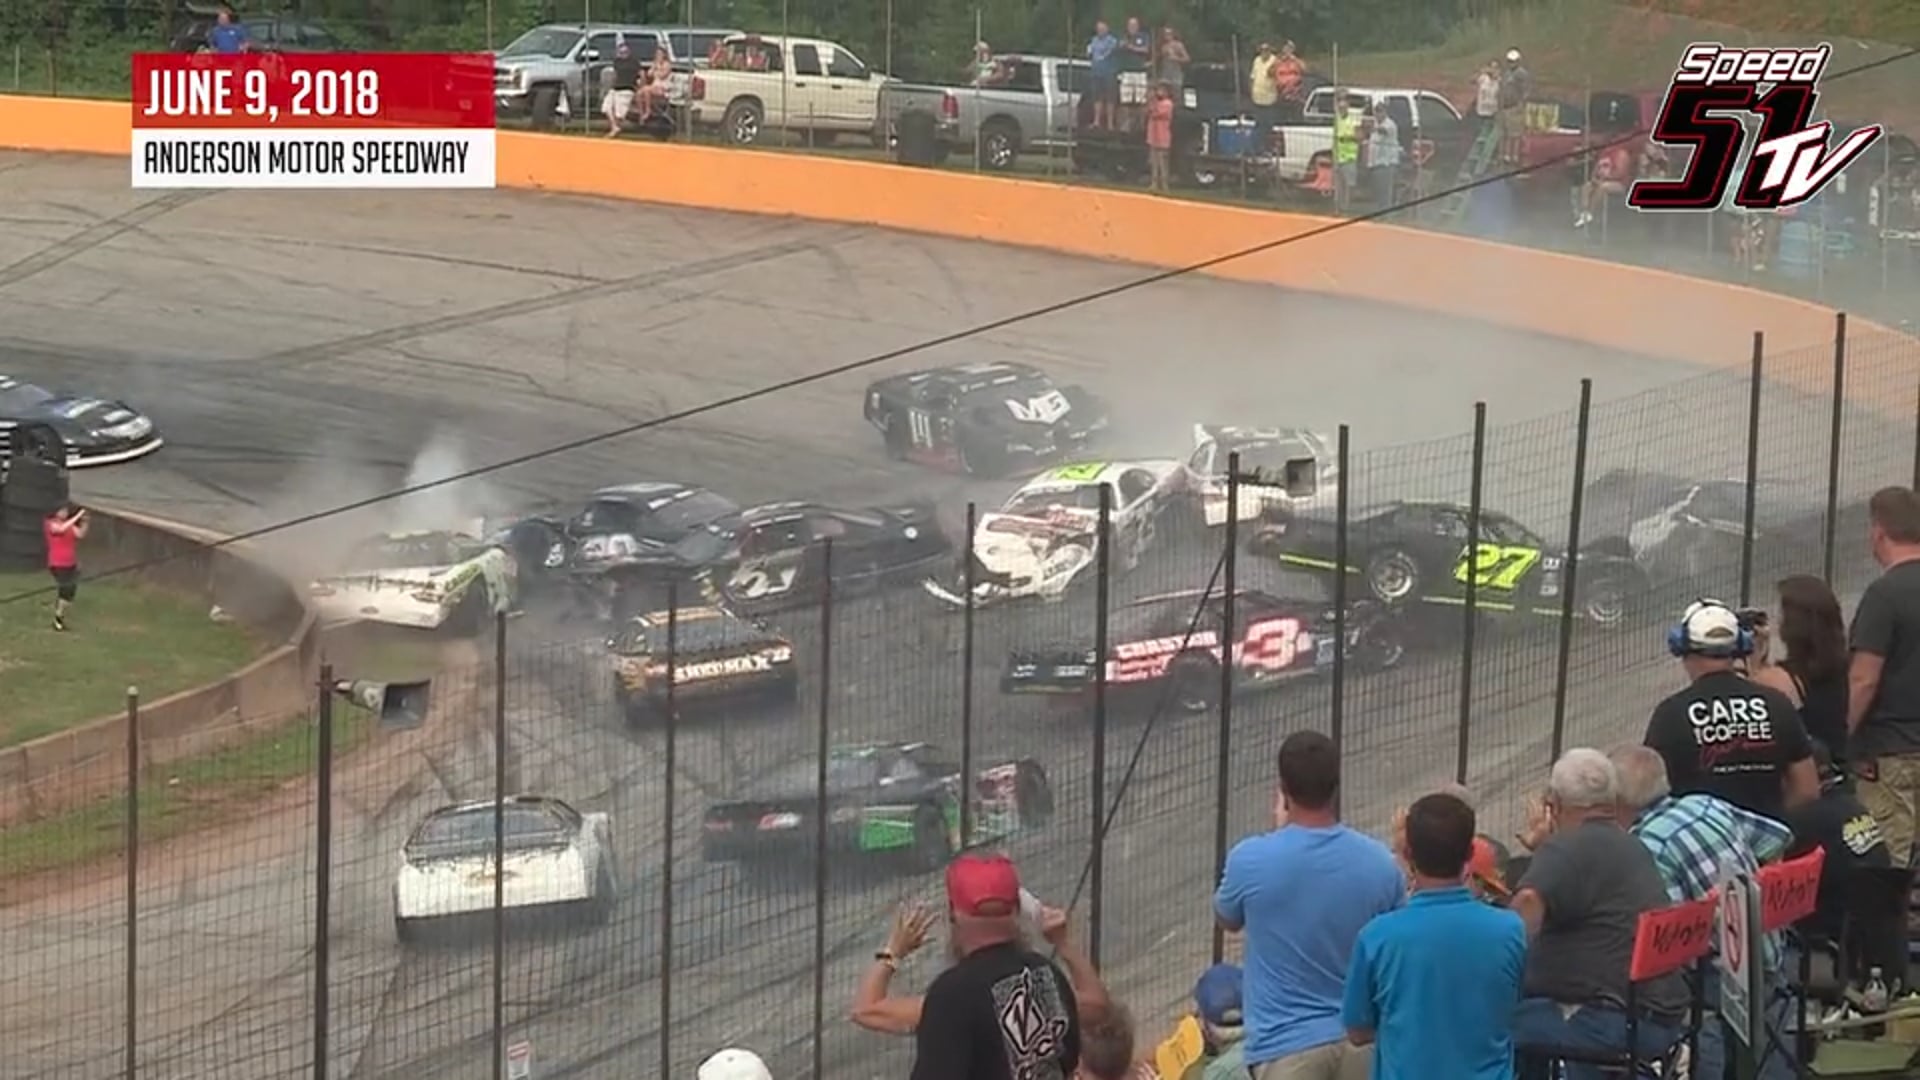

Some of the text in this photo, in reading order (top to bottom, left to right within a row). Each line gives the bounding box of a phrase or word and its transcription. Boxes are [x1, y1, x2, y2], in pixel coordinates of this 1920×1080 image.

[1453, 542, 1541, 590] 27
[1240, 615, 1301, 670] 3
[1688, 697, 1768, 726] CARS
[1702, 721, 1772, 743] COFFEE
